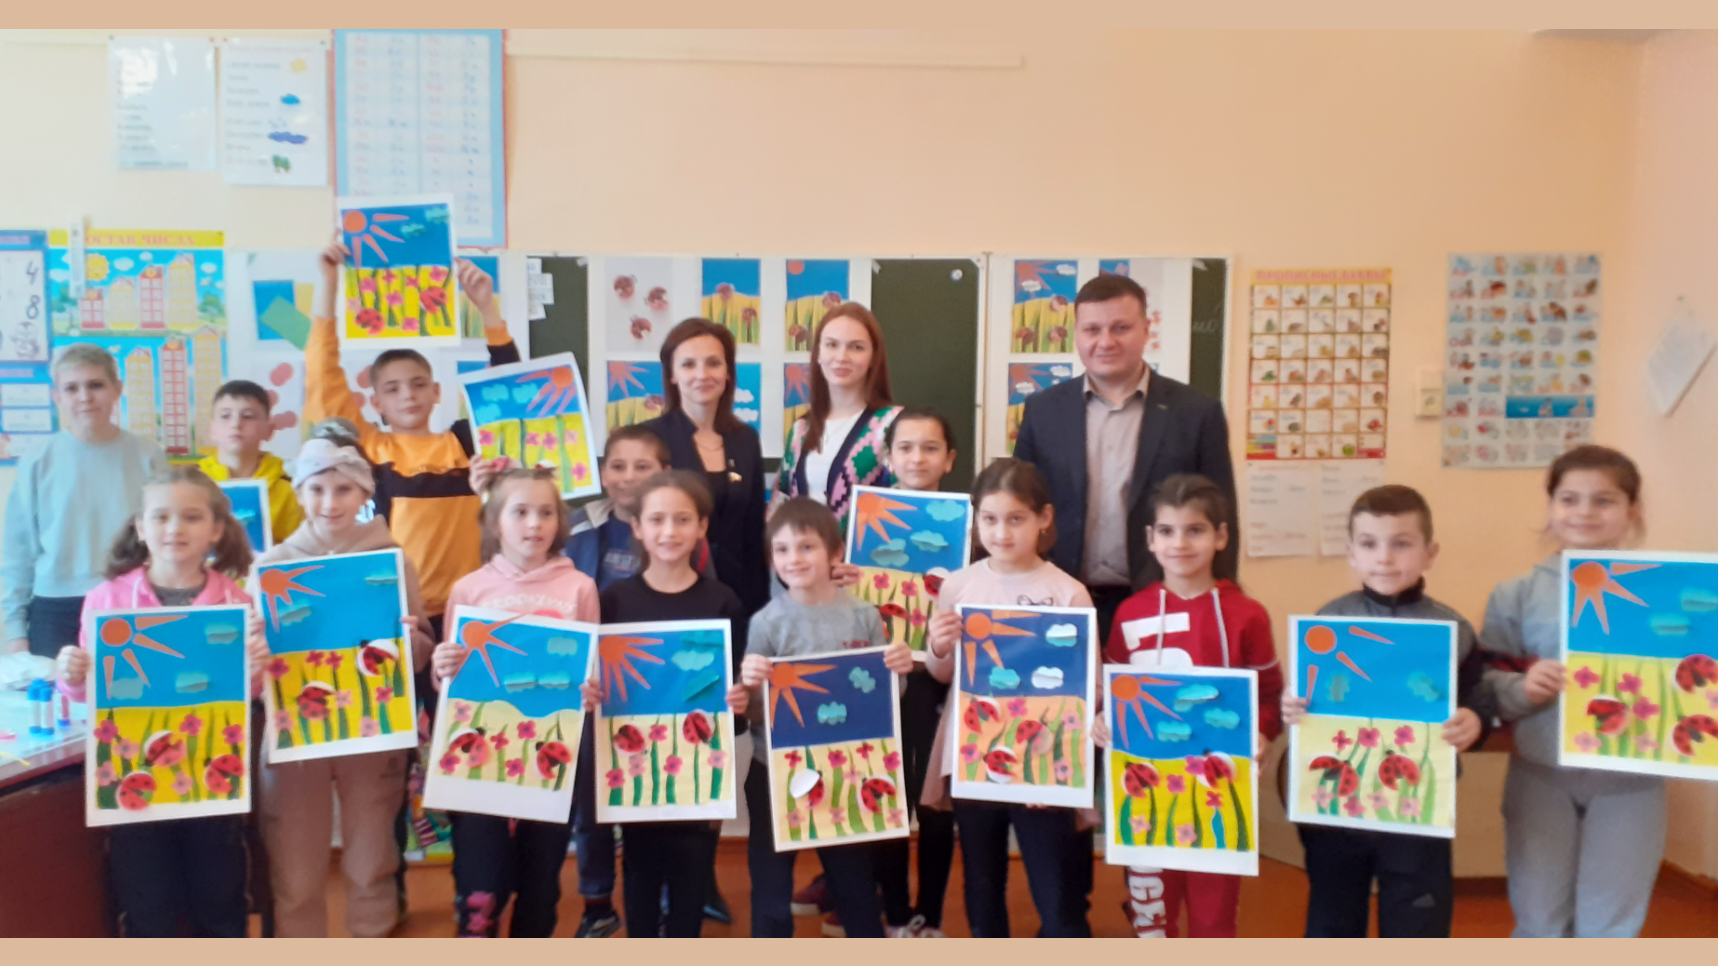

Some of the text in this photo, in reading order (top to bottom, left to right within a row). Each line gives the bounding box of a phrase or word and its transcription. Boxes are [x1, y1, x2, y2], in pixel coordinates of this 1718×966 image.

[83, 234, 196, 245] ОСТАВ ЧИСЛА
[26, 261, 39, 285] 4
[26, 294, 40, 319] 8
